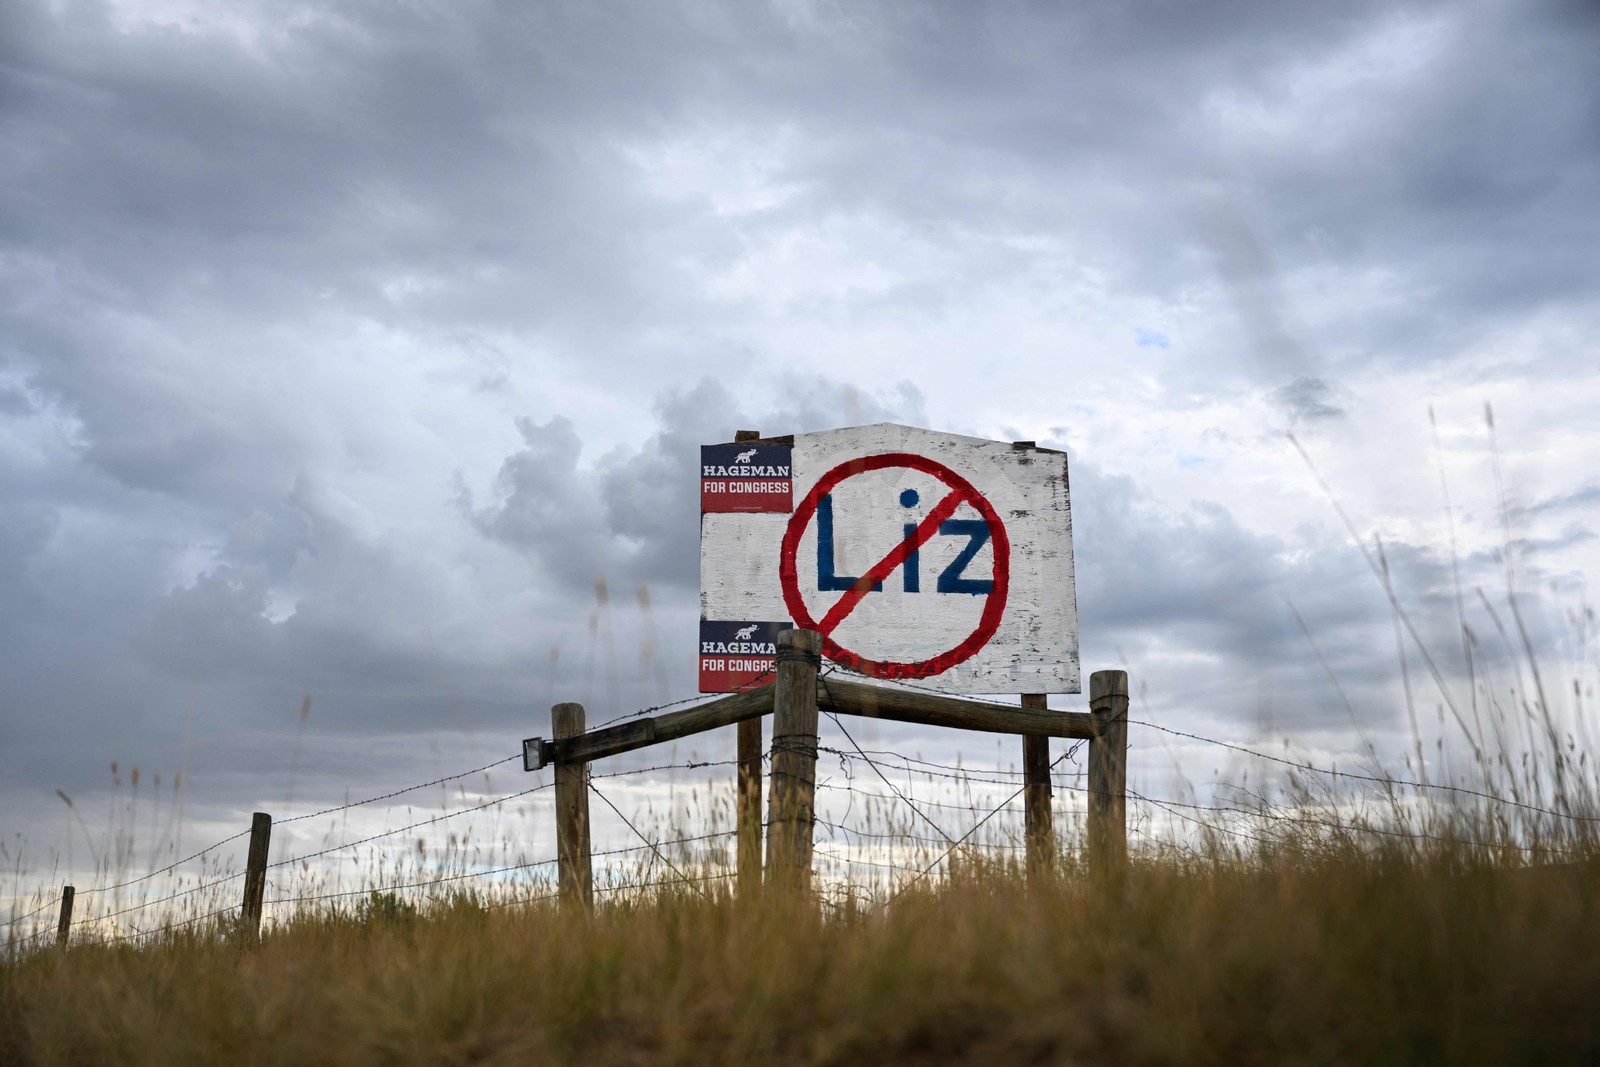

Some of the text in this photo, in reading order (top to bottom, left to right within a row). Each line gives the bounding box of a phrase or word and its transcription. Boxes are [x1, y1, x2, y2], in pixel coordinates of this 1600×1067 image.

[703, 465, 790, 477] HAGEMAN
[704, 481, 790, 494] FOR CONGRESS
[817, 488, 995, 594] Liz
[702, 641, 777, 655] HAGEMA
[702, 658, 777, 673] FOR CONGRE
